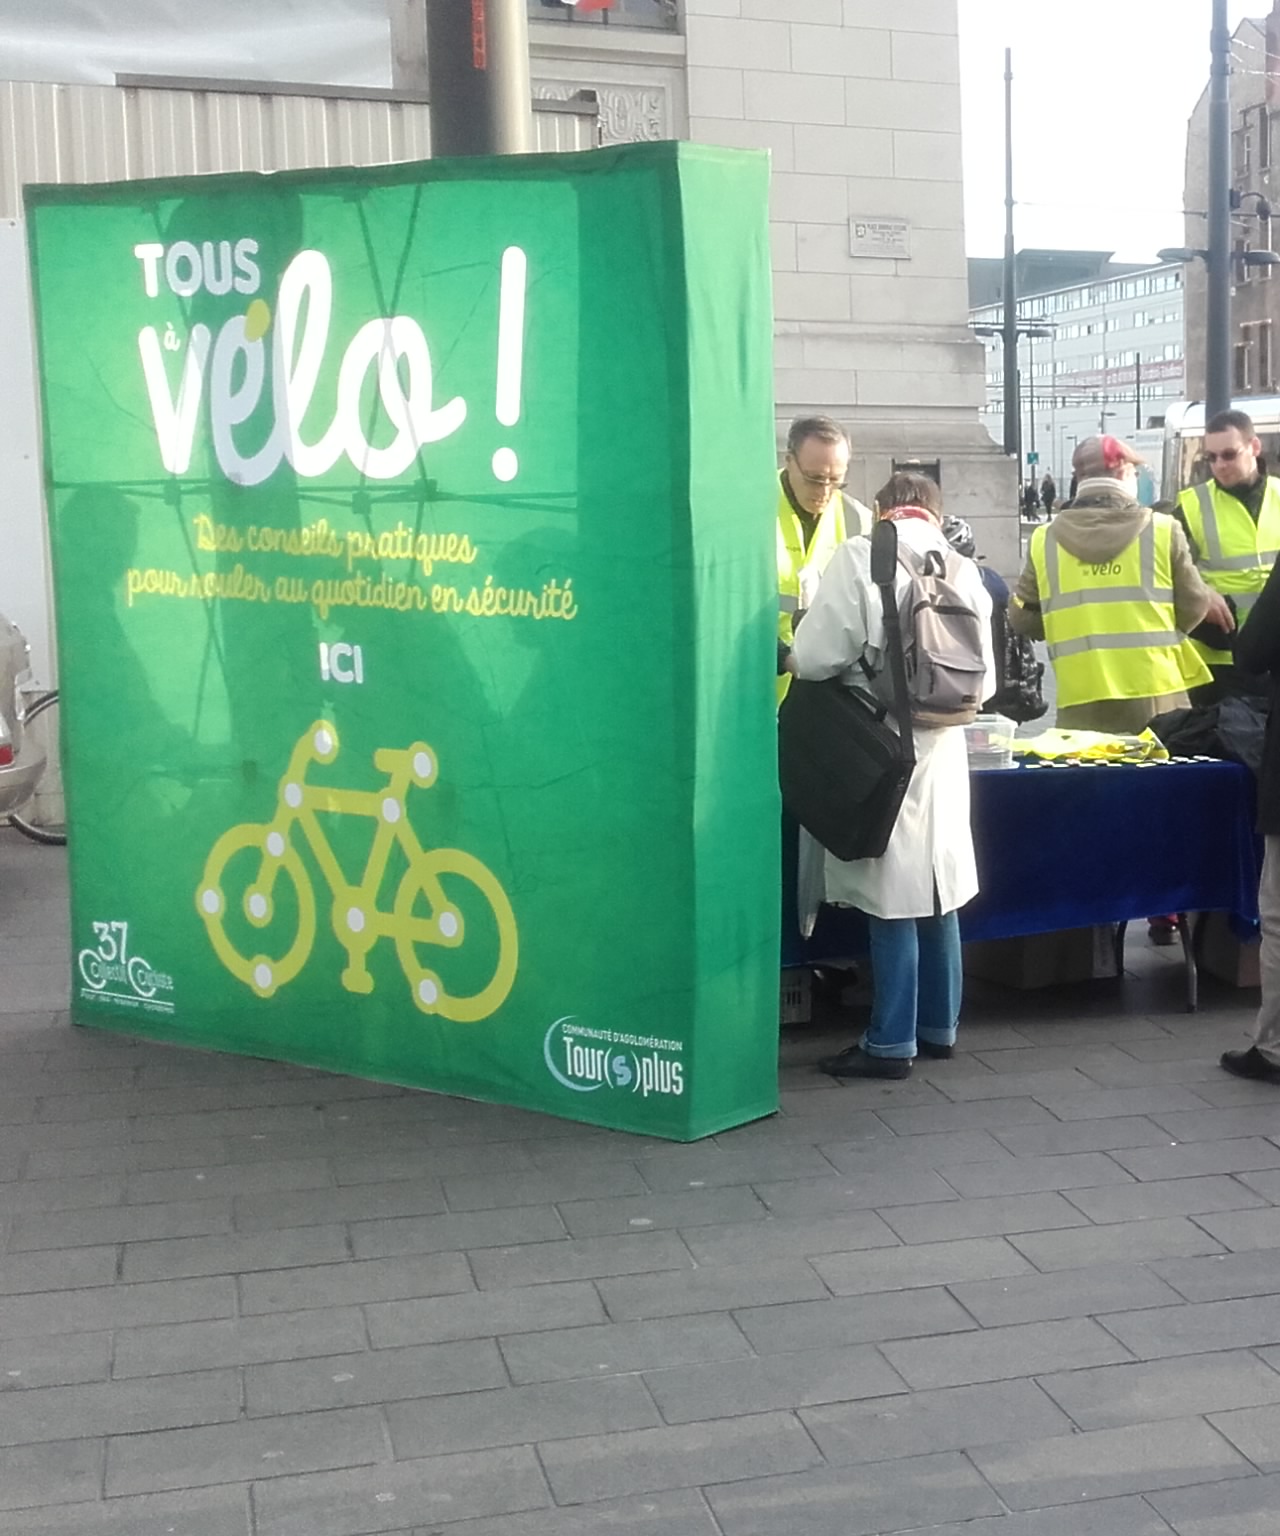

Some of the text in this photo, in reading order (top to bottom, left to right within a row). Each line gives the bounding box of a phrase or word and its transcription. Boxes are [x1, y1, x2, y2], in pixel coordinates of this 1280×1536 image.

[134, 238, 261, 298] TOUS
[163, 322, 182, 352] à
[138, 245, 527, 487] vélo !
[193, 513, 478, 577] Des conseils pratiques
[127, 563, 578, 620] pour rouler au quotidien en sécurité
[319, 643, 364, 684] ICI
[92, 921, 127, 964] 37
